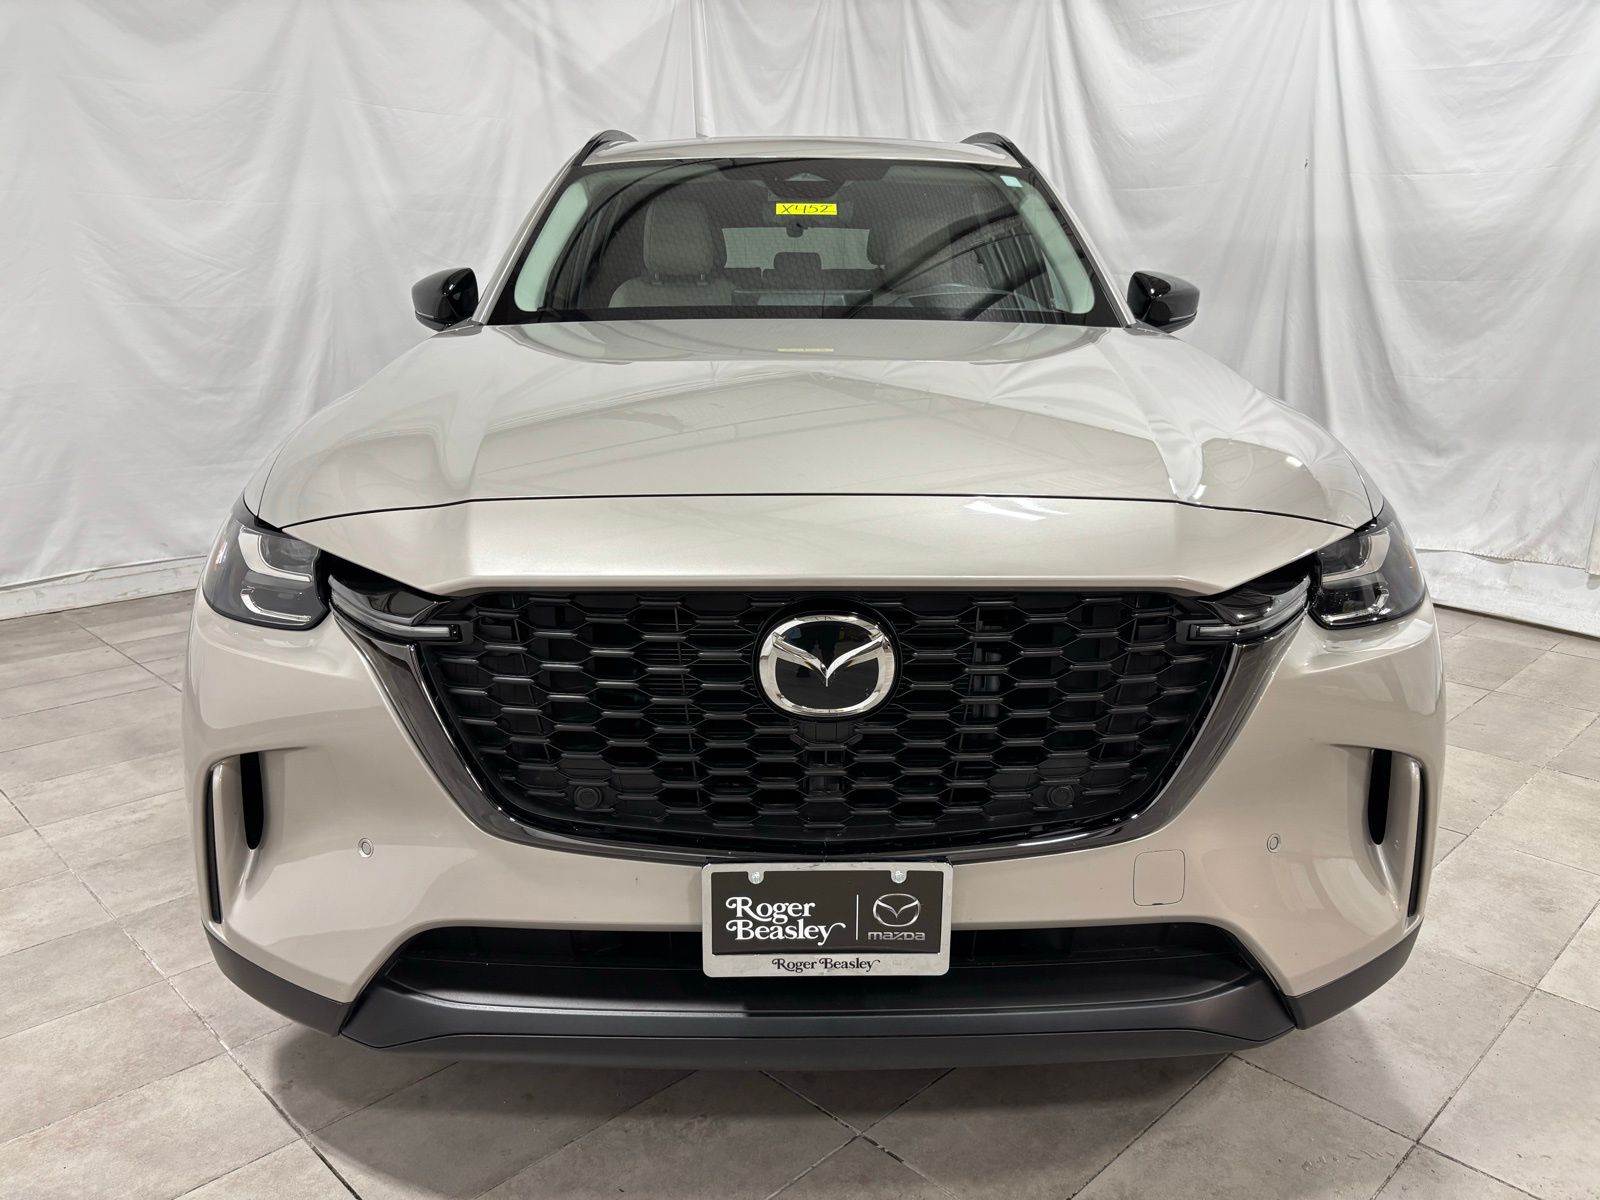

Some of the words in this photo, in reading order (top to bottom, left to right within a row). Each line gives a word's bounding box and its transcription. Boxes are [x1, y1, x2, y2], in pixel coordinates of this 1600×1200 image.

[781, 204, 836, 214] X452
[725, 896, 816, 924] Roger
[725, 919, 847, 946] Beasley
[771, 957, 818, 973] Roger
[818, 957, 881, 973] Beasley
